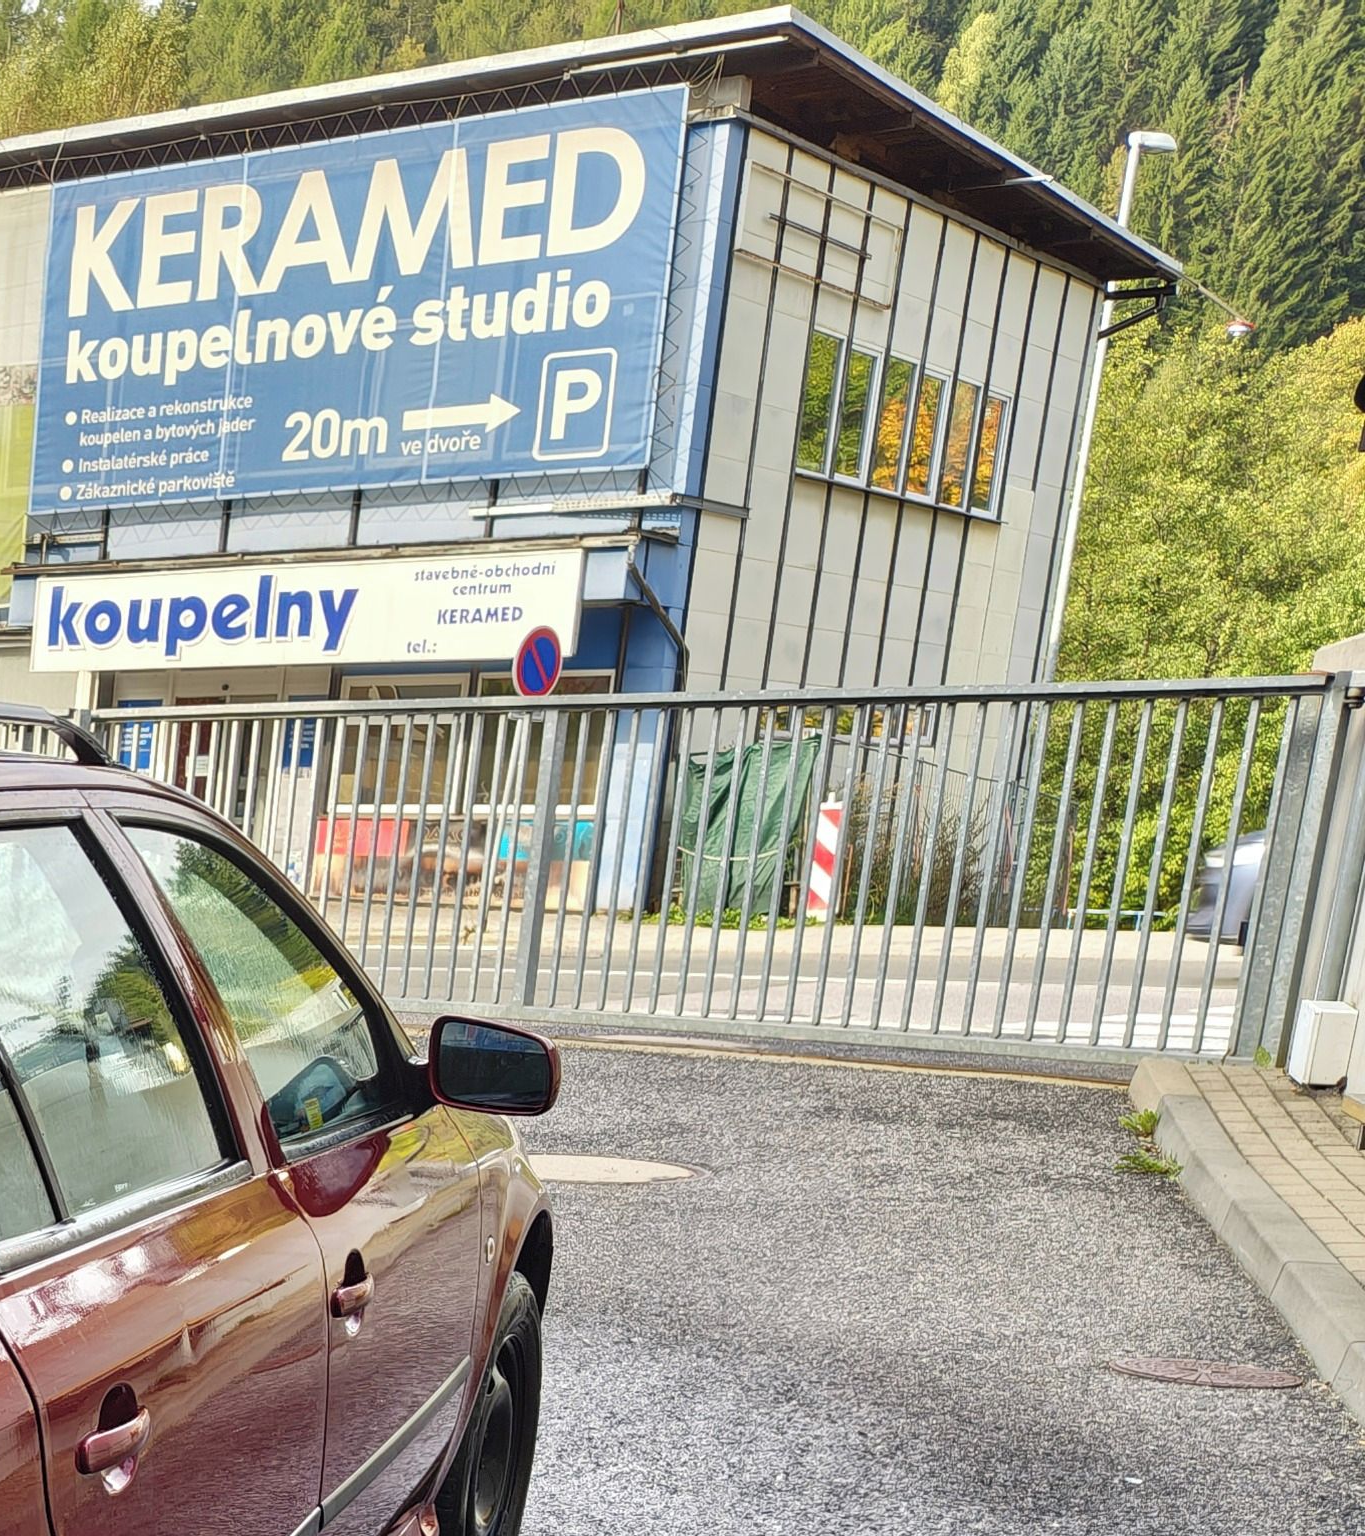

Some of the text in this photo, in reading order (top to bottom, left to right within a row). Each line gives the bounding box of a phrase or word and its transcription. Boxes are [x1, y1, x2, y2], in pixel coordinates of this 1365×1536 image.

[67, 127, 647, 318] KERAMED
[65, 269, 611, 385] koupelnové studio
[81, 395, 254, 424] Realizace a rekonstrukce
[79, 416, 257, 447] koupelen a bytových jader
[281, 408, 481, 462] 20m ve dvoře
[78, 448, 209, 473] Instalatérské práce
[76, 470, 236, 500] Zákaznické parkoviště
[453, 583, 512, 596] centrum
[47, 574, 360, 658] koupelny
[437, 606, 524, 625] KERAMED
[407, 639, 437, 654] tel.:
